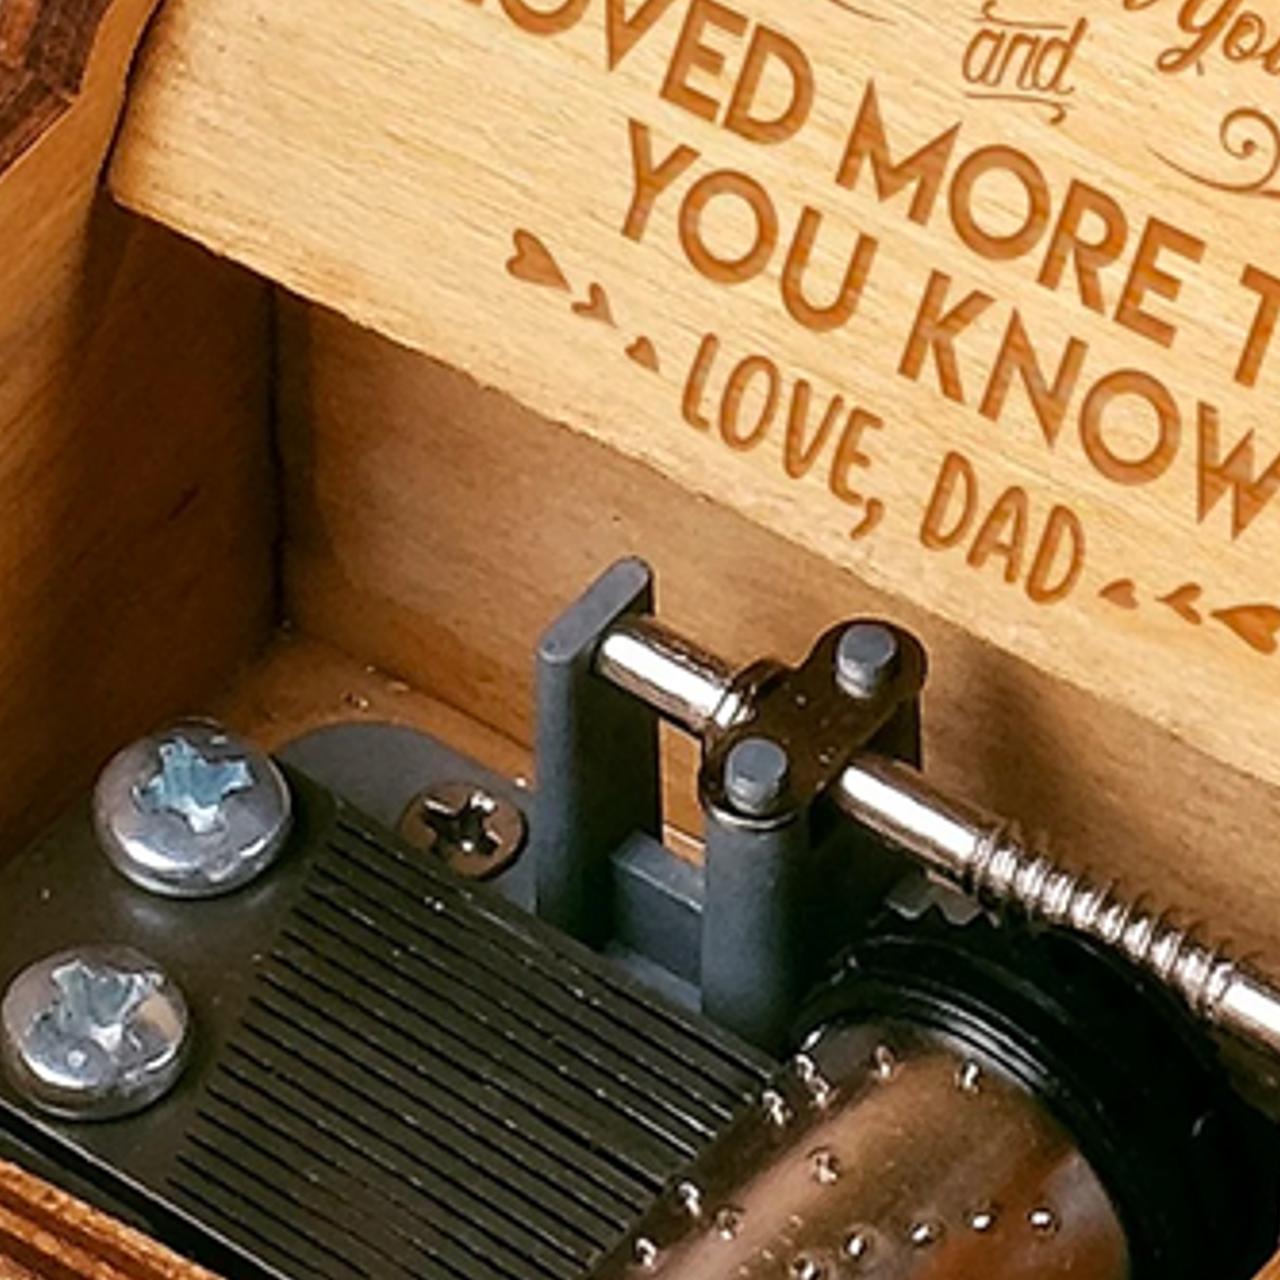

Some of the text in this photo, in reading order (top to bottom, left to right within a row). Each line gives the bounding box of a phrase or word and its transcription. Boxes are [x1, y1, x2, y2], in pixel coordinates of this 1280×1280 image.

[962, 8, 1088, 108] and
[620, 118, 876, 334] YOU
[836, 81, 1207, 349] MORE
[678, 329, 1087, 607] LOVE, DAD
